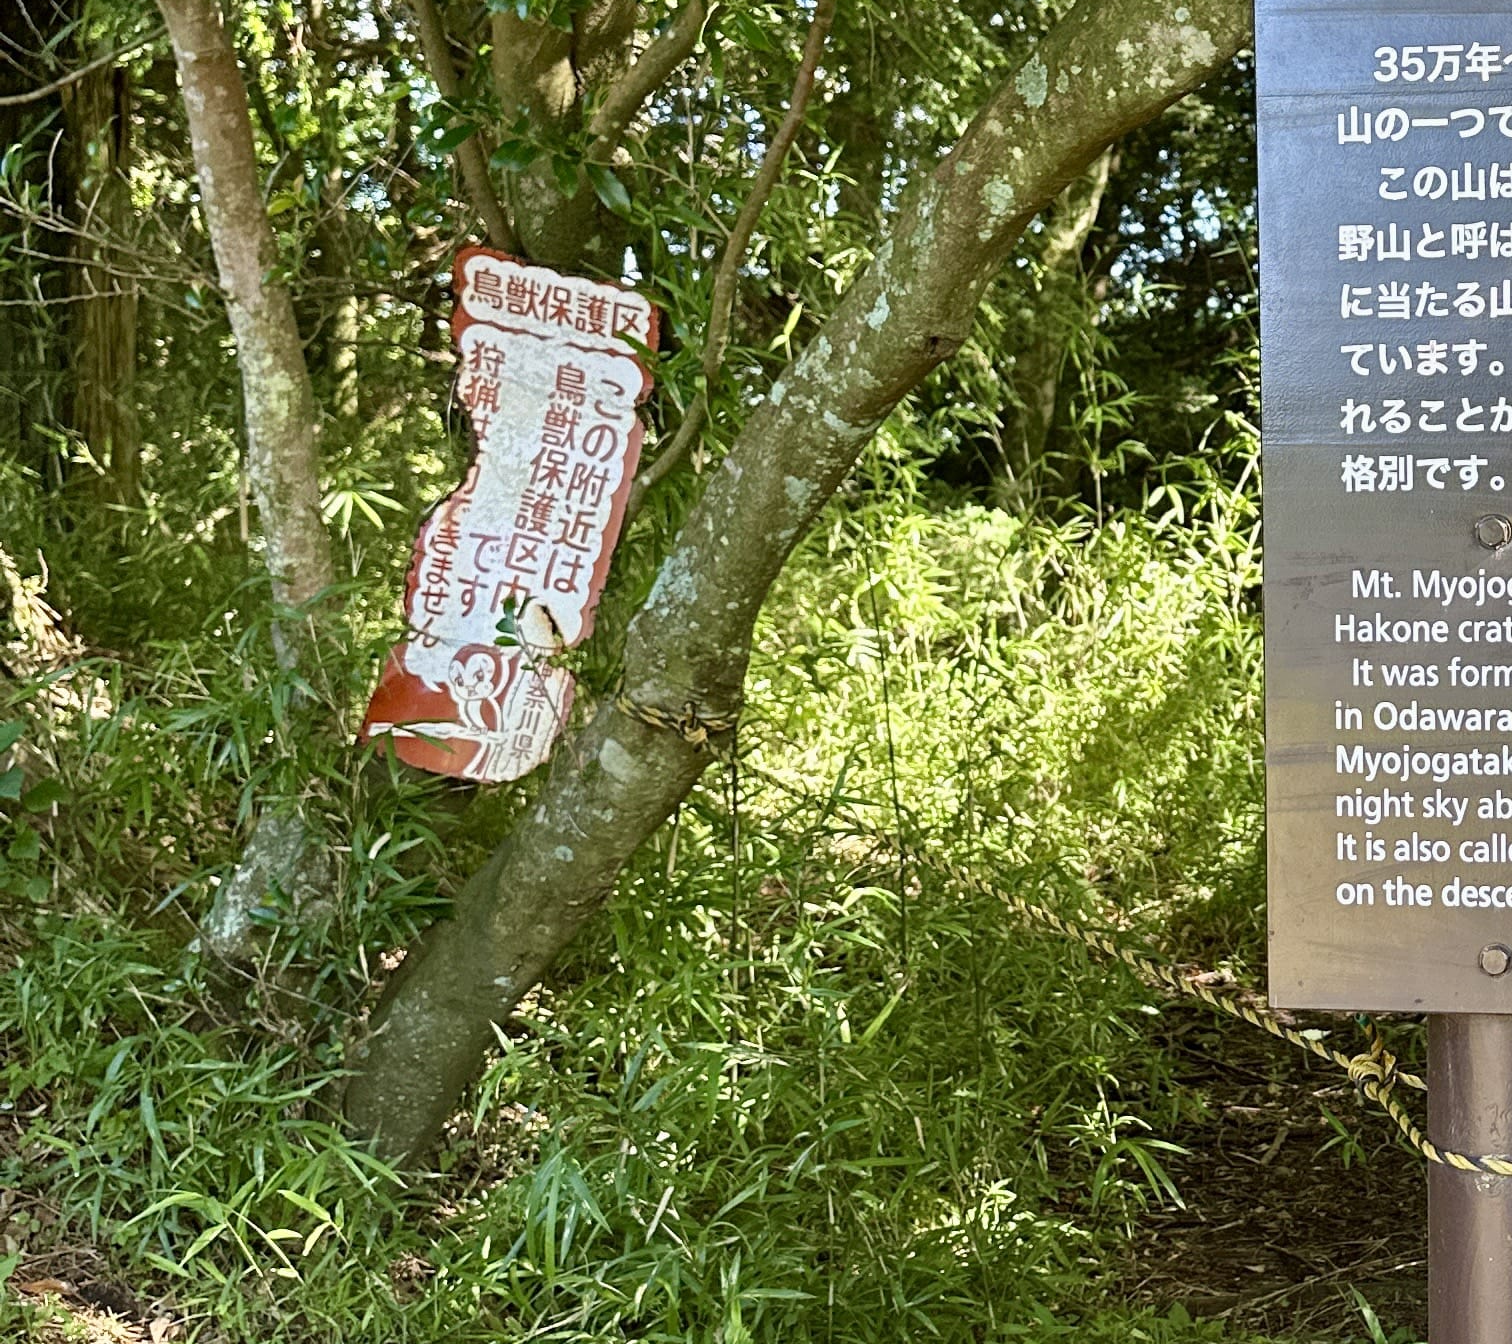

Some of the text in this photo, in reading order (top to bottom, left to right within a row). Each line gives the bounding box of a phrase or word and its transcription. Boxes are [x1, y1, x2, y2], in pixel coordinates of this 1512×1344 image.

[468, 266, 645, 339] 鳥獣保護区
[489, 361, 588, 619] 鳥獣保護区内
[542, 377, 626, 594] この附近は
[1340, 454, 1505, 493] 格別です。
[457, 532, 502, 618] です
[1352, 569, 1402, 599] Mt.
[1335, 612, 1449, 643] Hakone
[1353, 658, 1374, 687] It
[1381, 664, 1439, 687] was
[1335, 700, 1363, 730] in
[1336, 787, 1415, 825] night
[1422, 788, 1469, 826] sky
[1337, 832, 1358, 861] It
[1365, 831, 1386, 862] is
[1393, 831, 1451, 862] also
[1336, 882, 1374, 905] on
[1382, 875, 1433, 907] the
